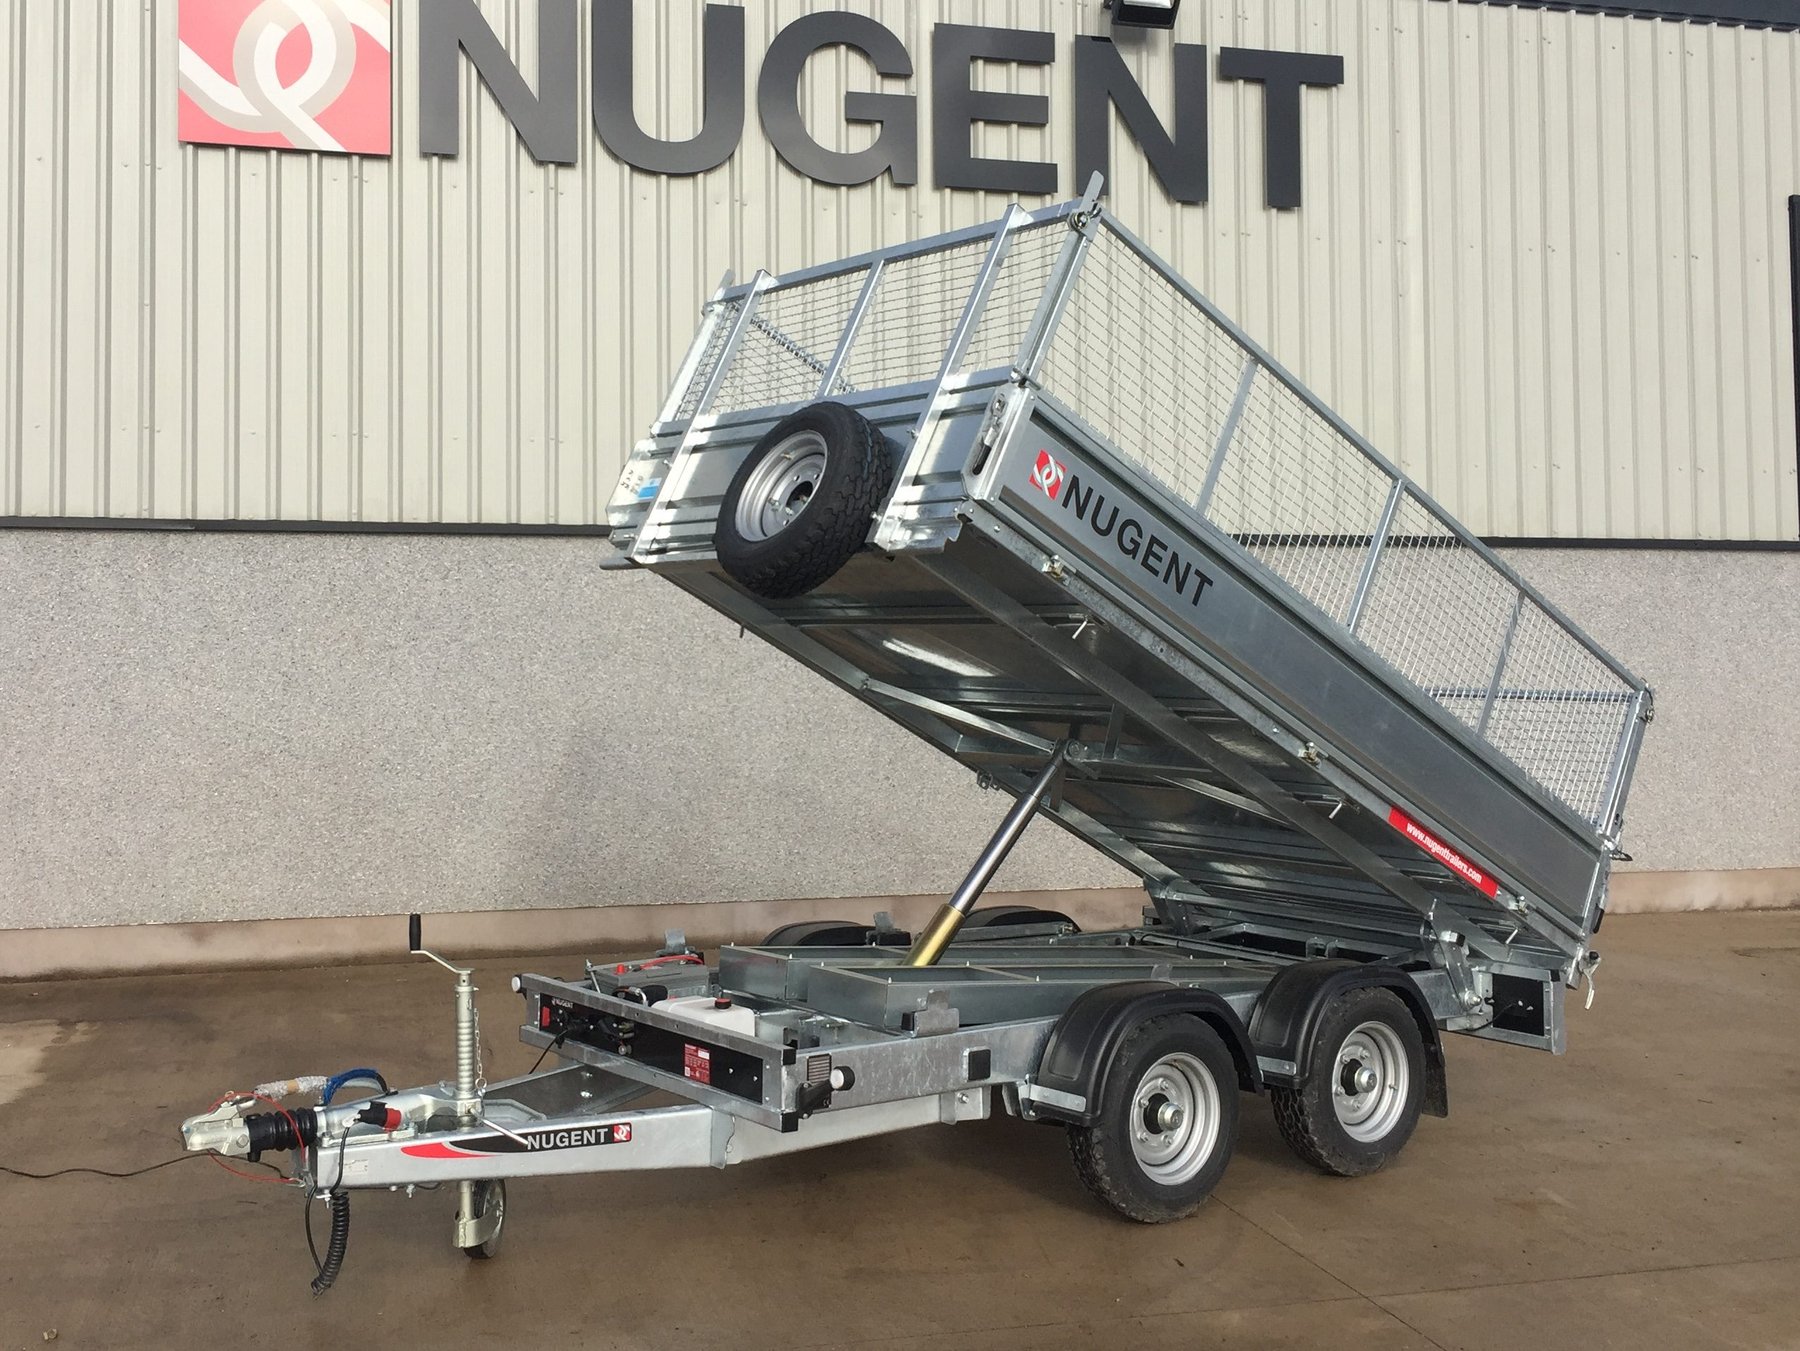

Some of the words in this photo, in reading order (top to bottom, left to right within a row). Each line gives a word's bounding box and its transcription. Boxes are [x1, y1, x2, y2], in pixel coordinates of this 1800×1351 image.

[419, 0, 1344, 209] NUGENT
[1062, 475, 1213, 606] NUGENT
[1406, 822, 1482, 884] www.nugenttrailers.com
[527, 1128, 608, 1150] NUGENT
